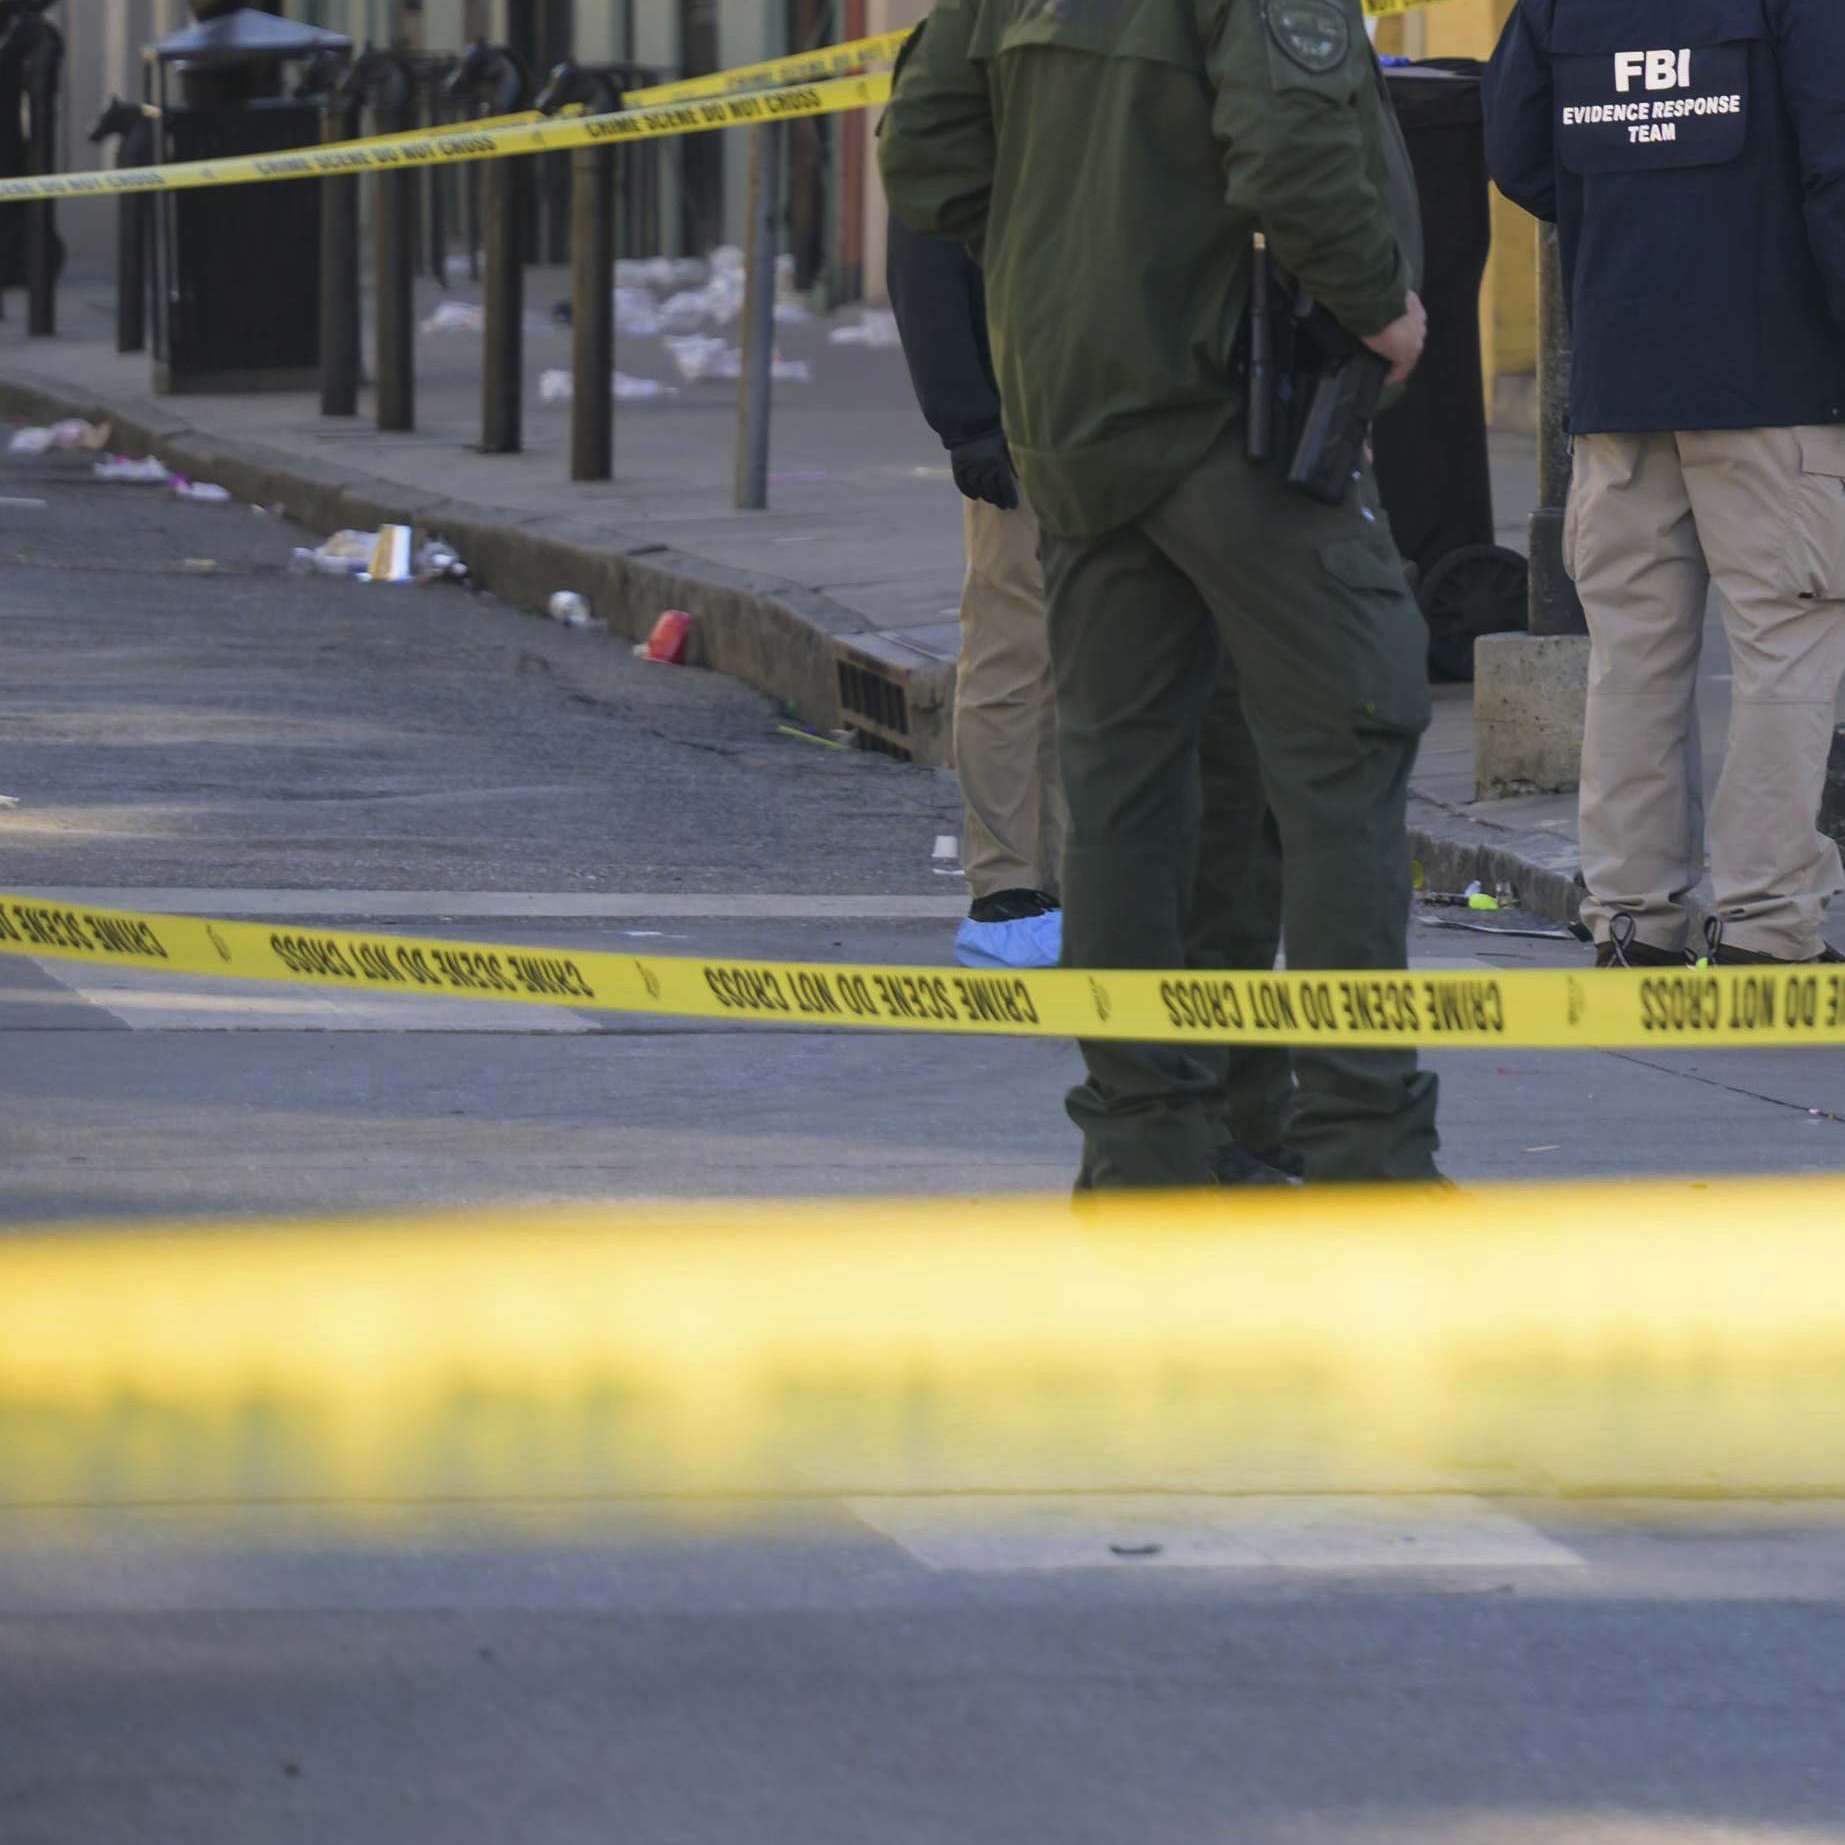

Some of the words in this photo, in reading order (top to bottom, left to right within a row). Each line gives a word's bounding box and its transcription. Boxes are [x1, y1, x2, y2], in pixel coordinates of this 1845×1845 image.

[1614, 48, 1691, 92] FBI
[585, 112, 641, 138] CRIME
[643, 104, 699, 131] SCENE
[702, 98, 727, 123] DO
[728, 94, 763, 119] NOT
[763, 86, 822, 113] CROSS
[1563, 102, 1650, 125] EVIDENCE
[1652, 95, 1740, 120] RESPONSE
[1628, 123, 1676, 143] TEAM
[12, 905, 95, 950] SCENE
[83, 914, 169, 959] CRIME
[270, 933, 357, 978] CROSS
[348, 942, 407, 982] NOT
[396, 944, 443, 985] DO
[430, 948, 518, 992] SCENE
[507, 954, 594, 998] CRIME
[703, 966, 790, 1012] CROSS
[785, 970, 843, 1015] NOT
[836, 972, 881, 1016] DO
[872, 973, 959, 1021] SCENE
[952, 976, 1040, 1024] CRIME
[1160, 978, 1244, 1030] CROSS
[1247, 979, 1299, 1030] NOT
[1299, 980, 1338, 1031] DO
[1338, 980, 1421, 1031] SCENE
[1422, 979, 1504, 1032] CRIME
[1640, 976, 1721, 1031] CROSS
[1728, 974, 1776, 1029] NOT
[1783, 975, 1819, 1028] DO
